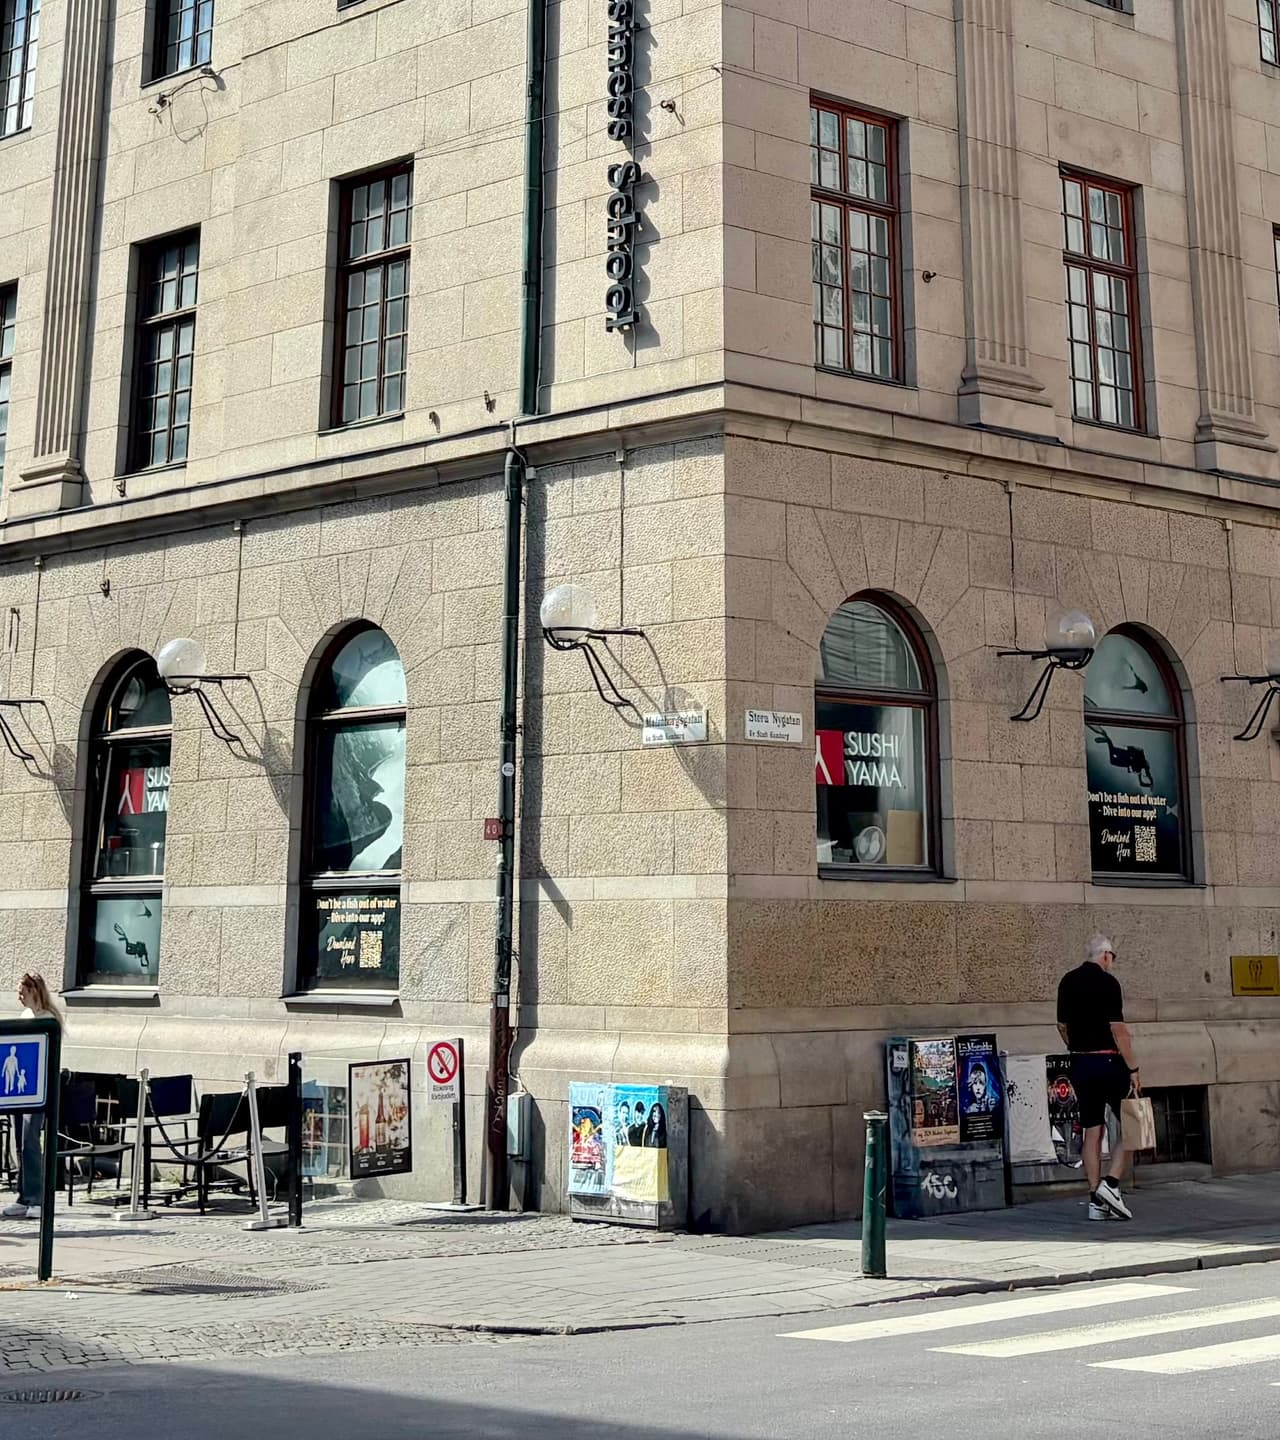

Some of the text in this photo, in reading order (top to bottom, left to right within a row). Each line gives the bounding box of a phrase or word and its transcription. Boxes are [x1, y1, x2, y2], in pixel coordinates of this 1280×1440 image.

[606, 160, 641, 333] School
[848, 731, 899, 758] SUSHI
[848, 760, 902, 787] YAMA
[1103, 805, 1117, 816] Dive
[1148, 795, 1167, 806] water
